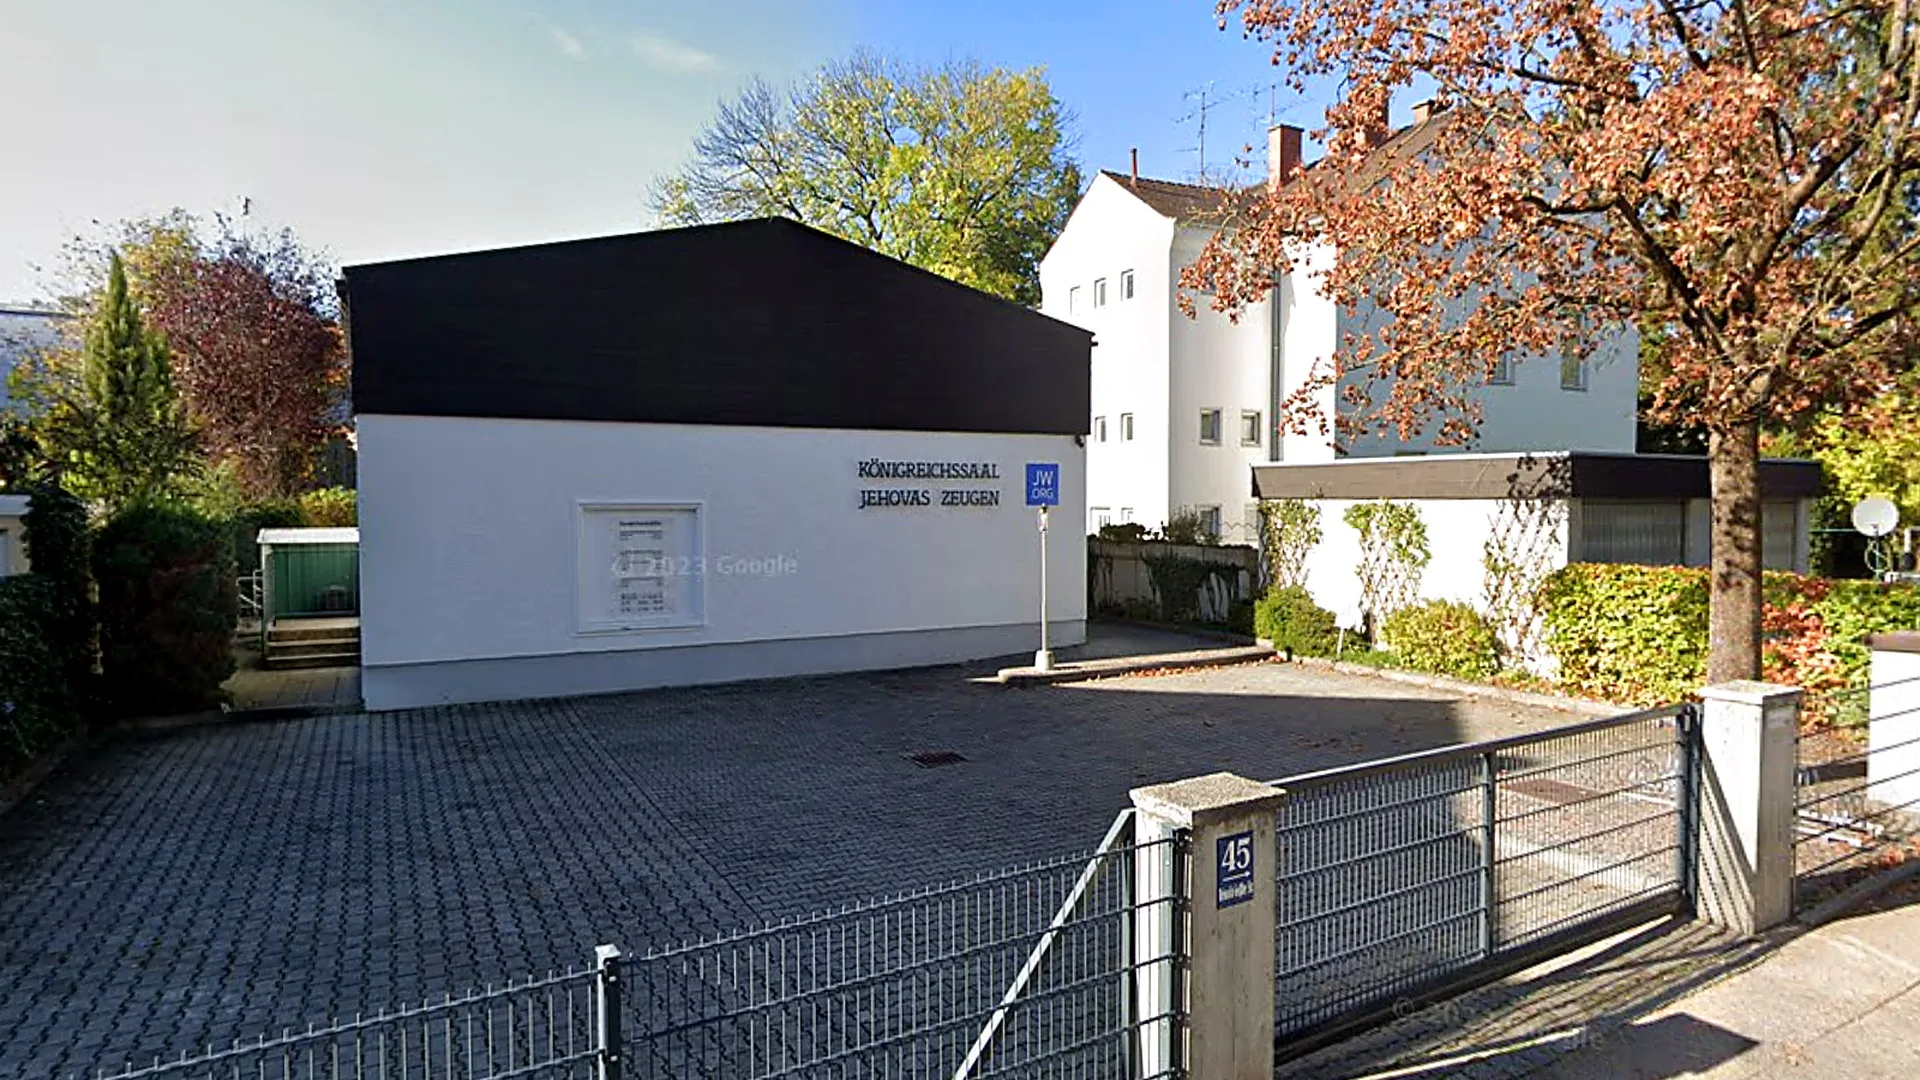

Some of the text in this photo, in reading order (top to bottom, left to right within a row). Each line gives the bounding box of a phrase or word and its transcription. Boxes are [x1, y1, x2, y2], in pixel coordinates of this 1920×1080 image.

[858, 458, 1000, 479] KÖNIGREICHSSAAL
[1033, 470, 1053, 486] JW
[858, 490, 1000, 509] JEHOVAS ZEUGEN
[1221, 837, 1250, 872] 45
